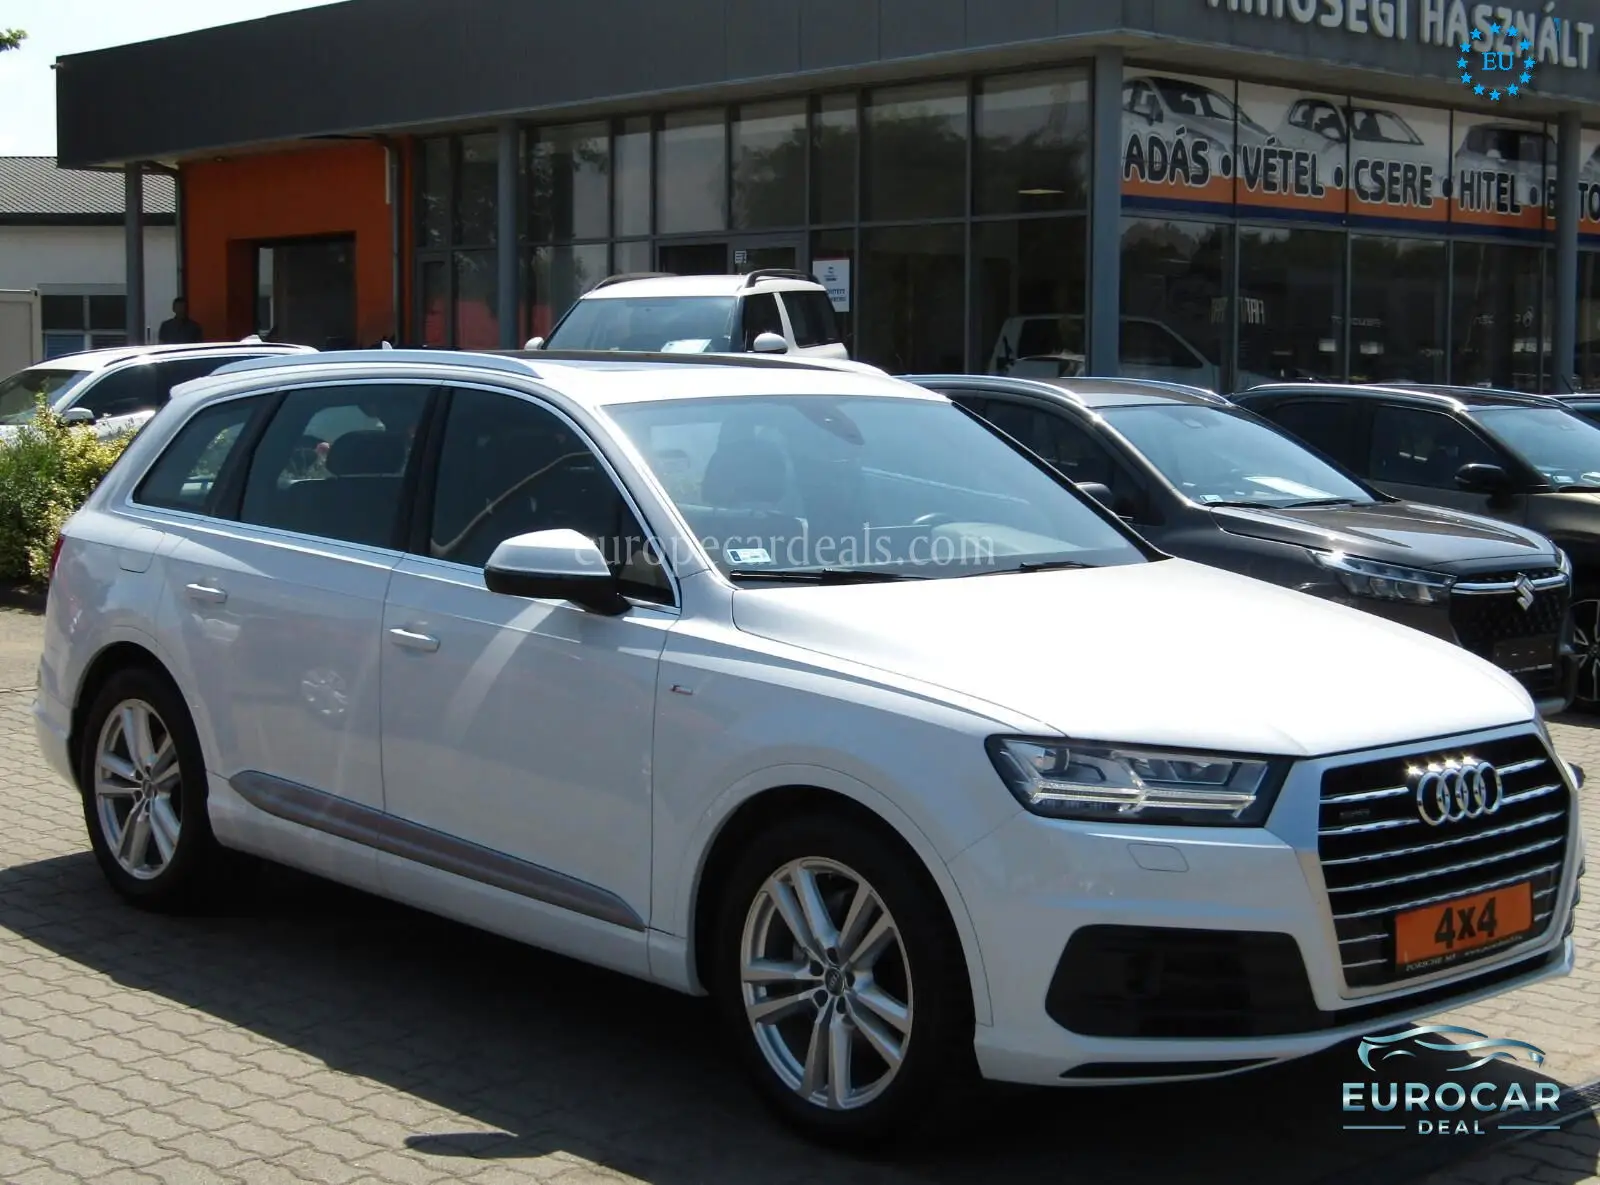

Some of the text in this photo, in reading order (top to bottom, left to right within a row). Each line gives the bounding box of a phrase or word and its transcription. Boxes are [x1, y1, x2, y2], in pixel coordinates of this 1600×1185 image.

[1420, 0, 1594, 69] HASZNÁLT
[1123, 125, 1210, 187] ADÁS
[1242, 136, 1325, 197] VÉTEL
[1354, 159, 1434, 207] CSERE
[1459, 169, 1522, 214] HITEL
